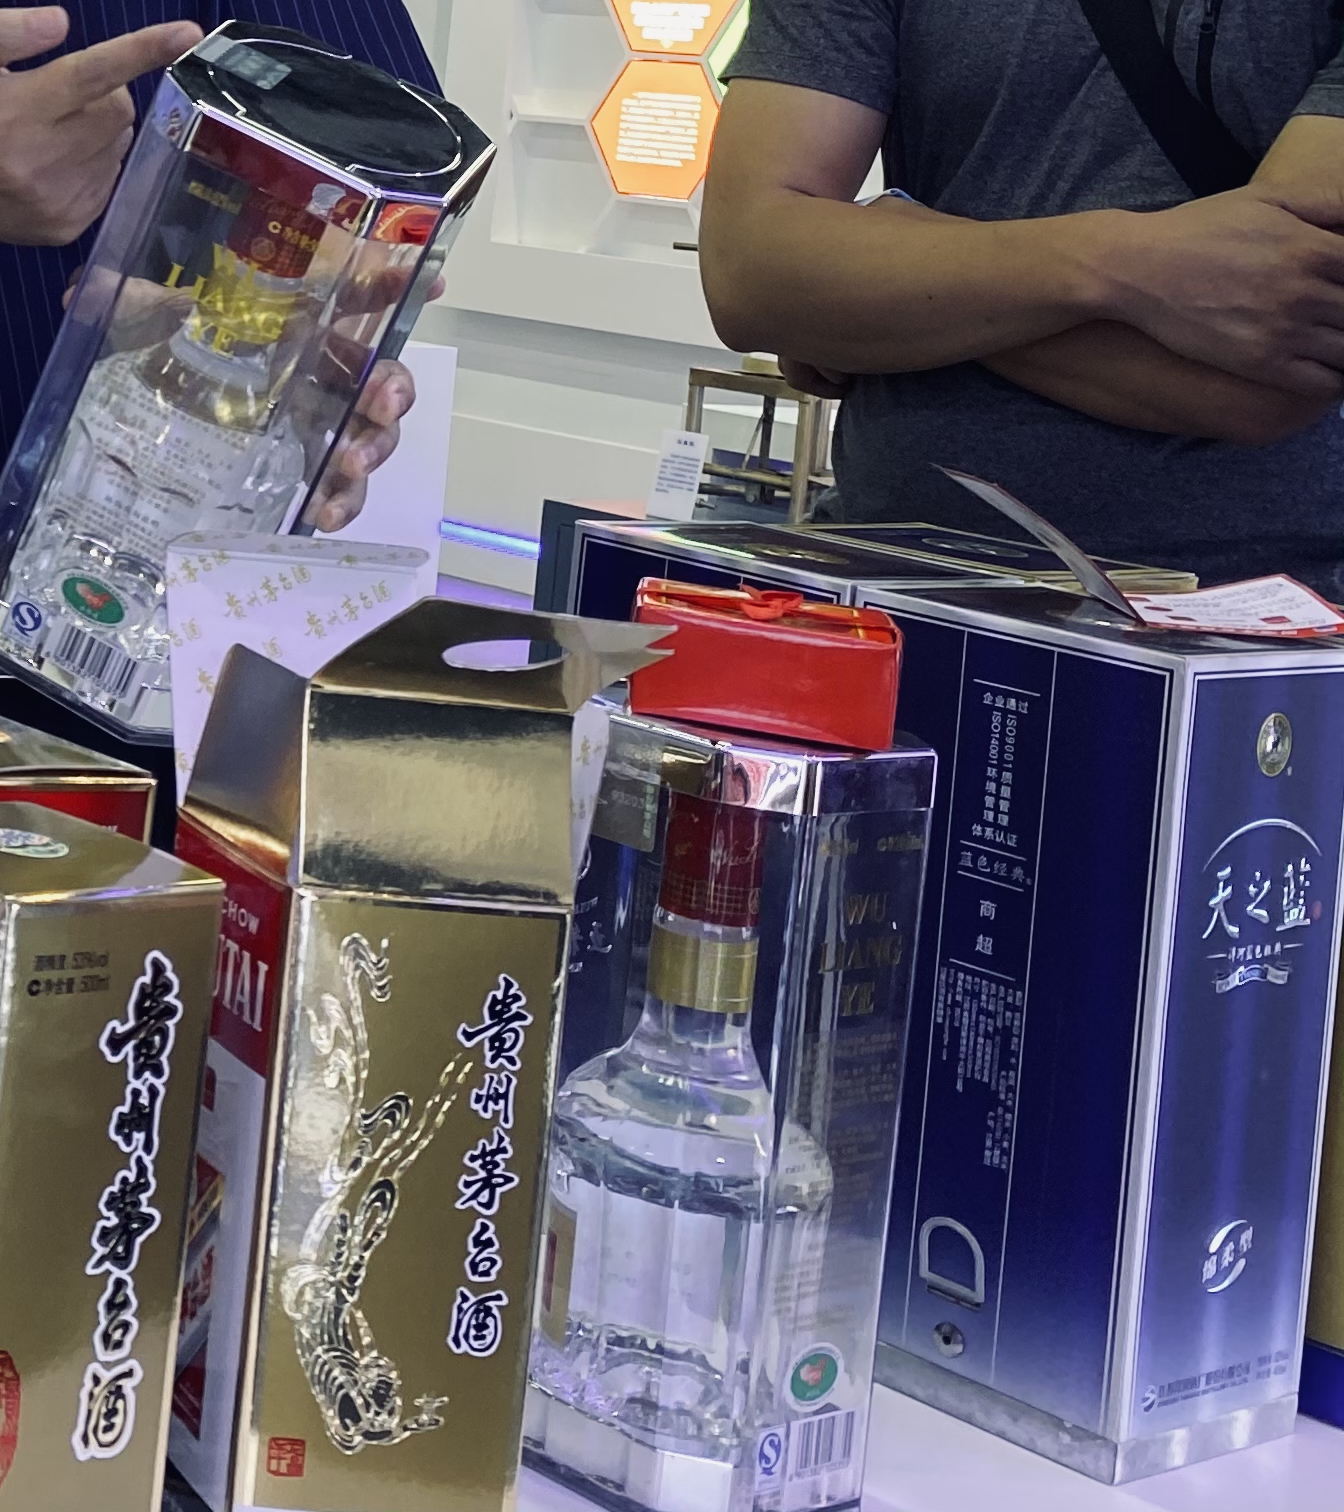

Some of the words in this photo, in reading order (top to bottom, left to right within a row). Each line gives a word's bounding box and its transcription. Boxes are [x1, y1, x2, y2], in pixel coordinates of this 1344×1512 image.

[983, 691, 1029, 714] 企业通过
[971, 823, 1018, 848] 体系认证
[1202, 857, 1311, 939] 天之蓝
